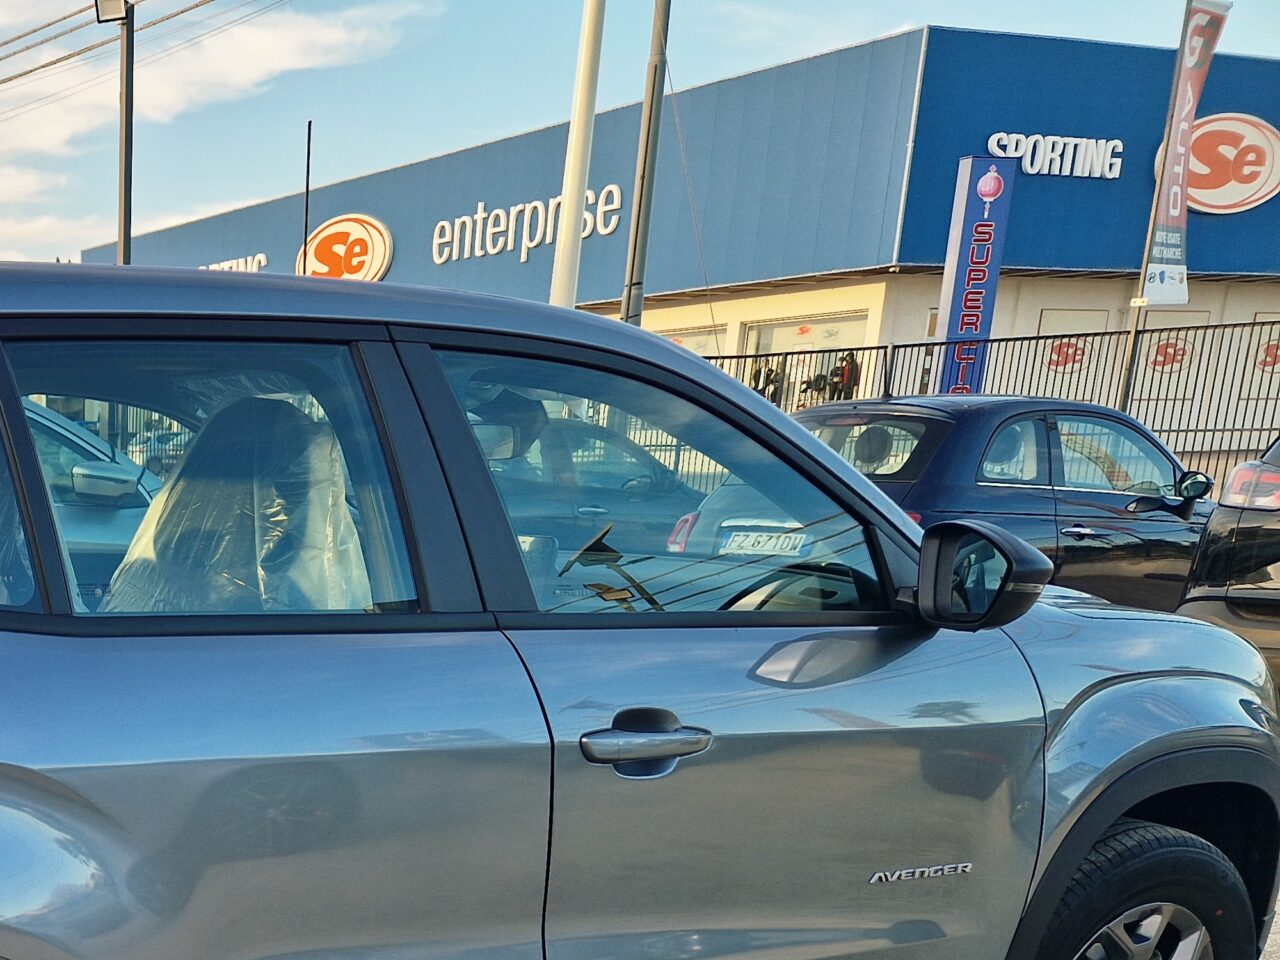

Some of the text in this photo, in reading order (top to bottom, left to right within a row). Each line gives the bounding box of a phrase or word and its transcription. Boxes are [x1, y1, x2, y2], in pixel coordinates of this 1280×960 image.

[987, 132, 1124, 179] SPORTING
[1187, 129, 1267, 190] Se
[432, 183, 622, 264] enterprse
[311, 231, 369, 278] Se
[958, 221, 995, 334] SUPER
[868, 862, 973, 884] AVENGER
